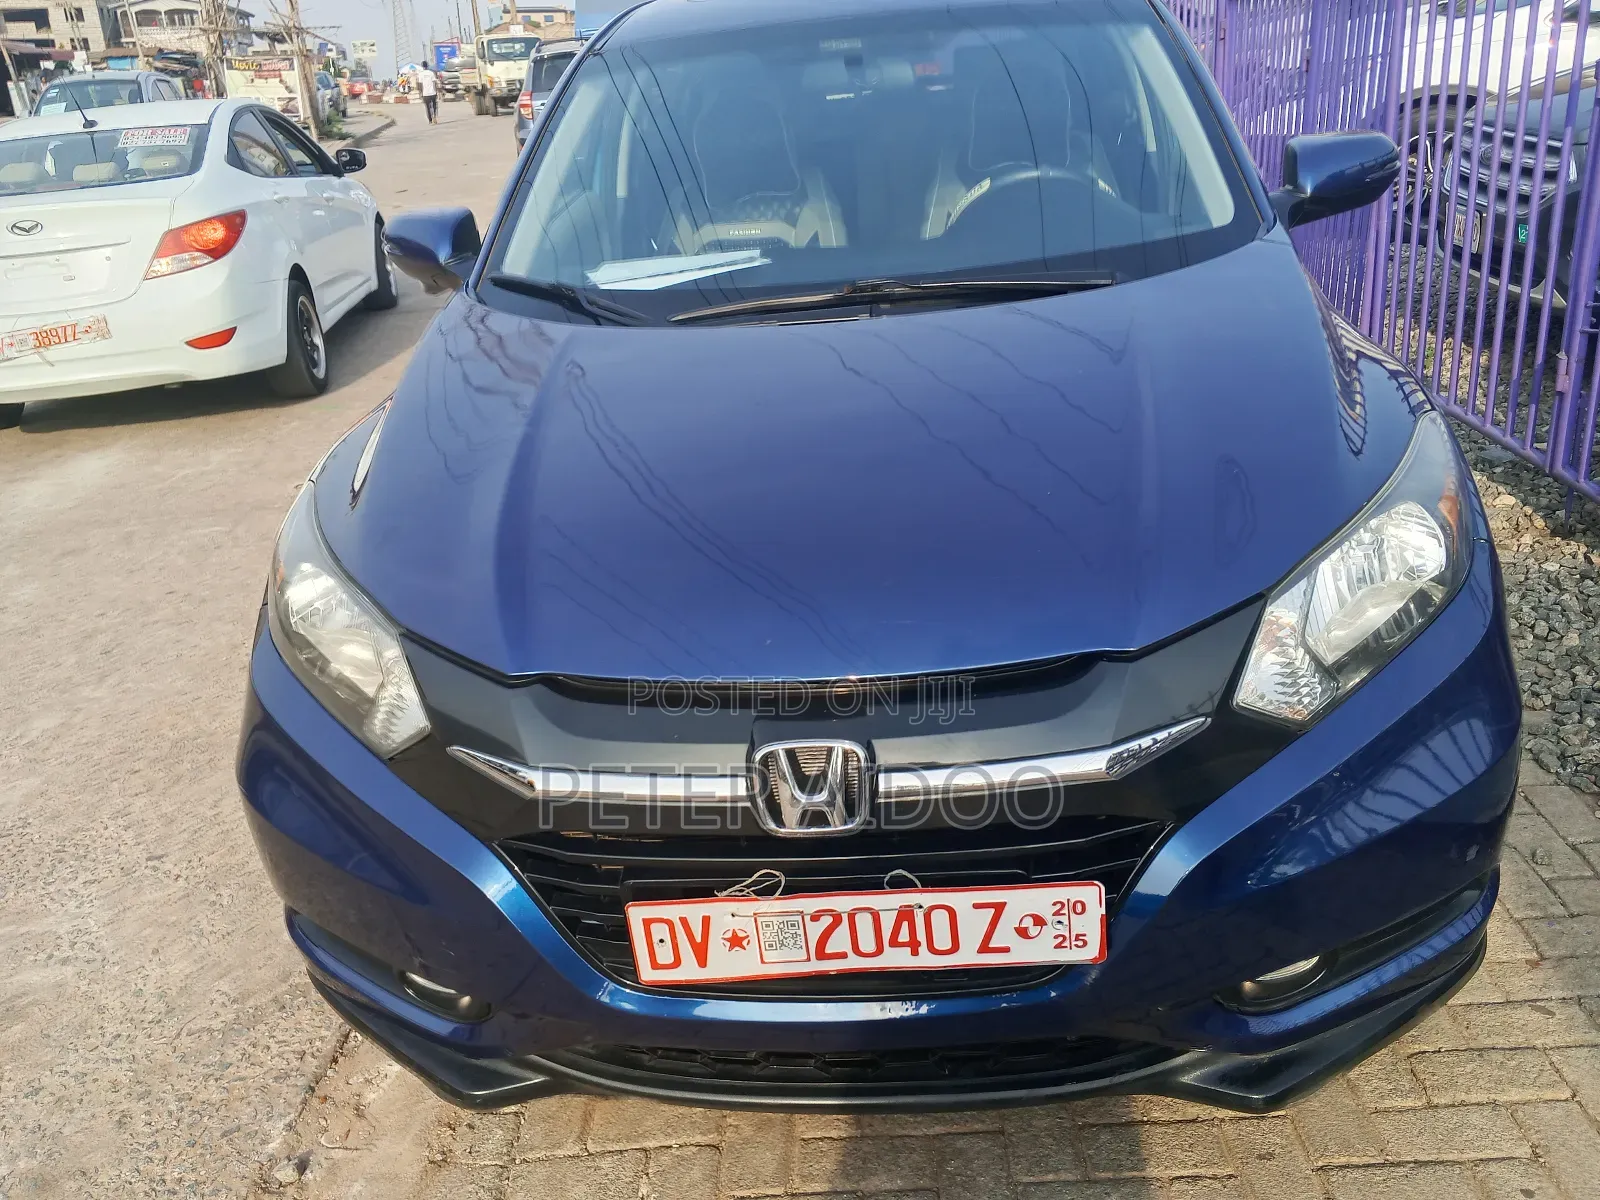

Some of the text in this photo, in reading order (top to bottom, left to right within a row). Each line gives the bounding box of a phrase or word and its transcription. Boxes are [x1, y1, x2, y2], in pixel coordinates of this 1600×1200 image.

[642, 901, 1011, 970] DV 2040 Z
